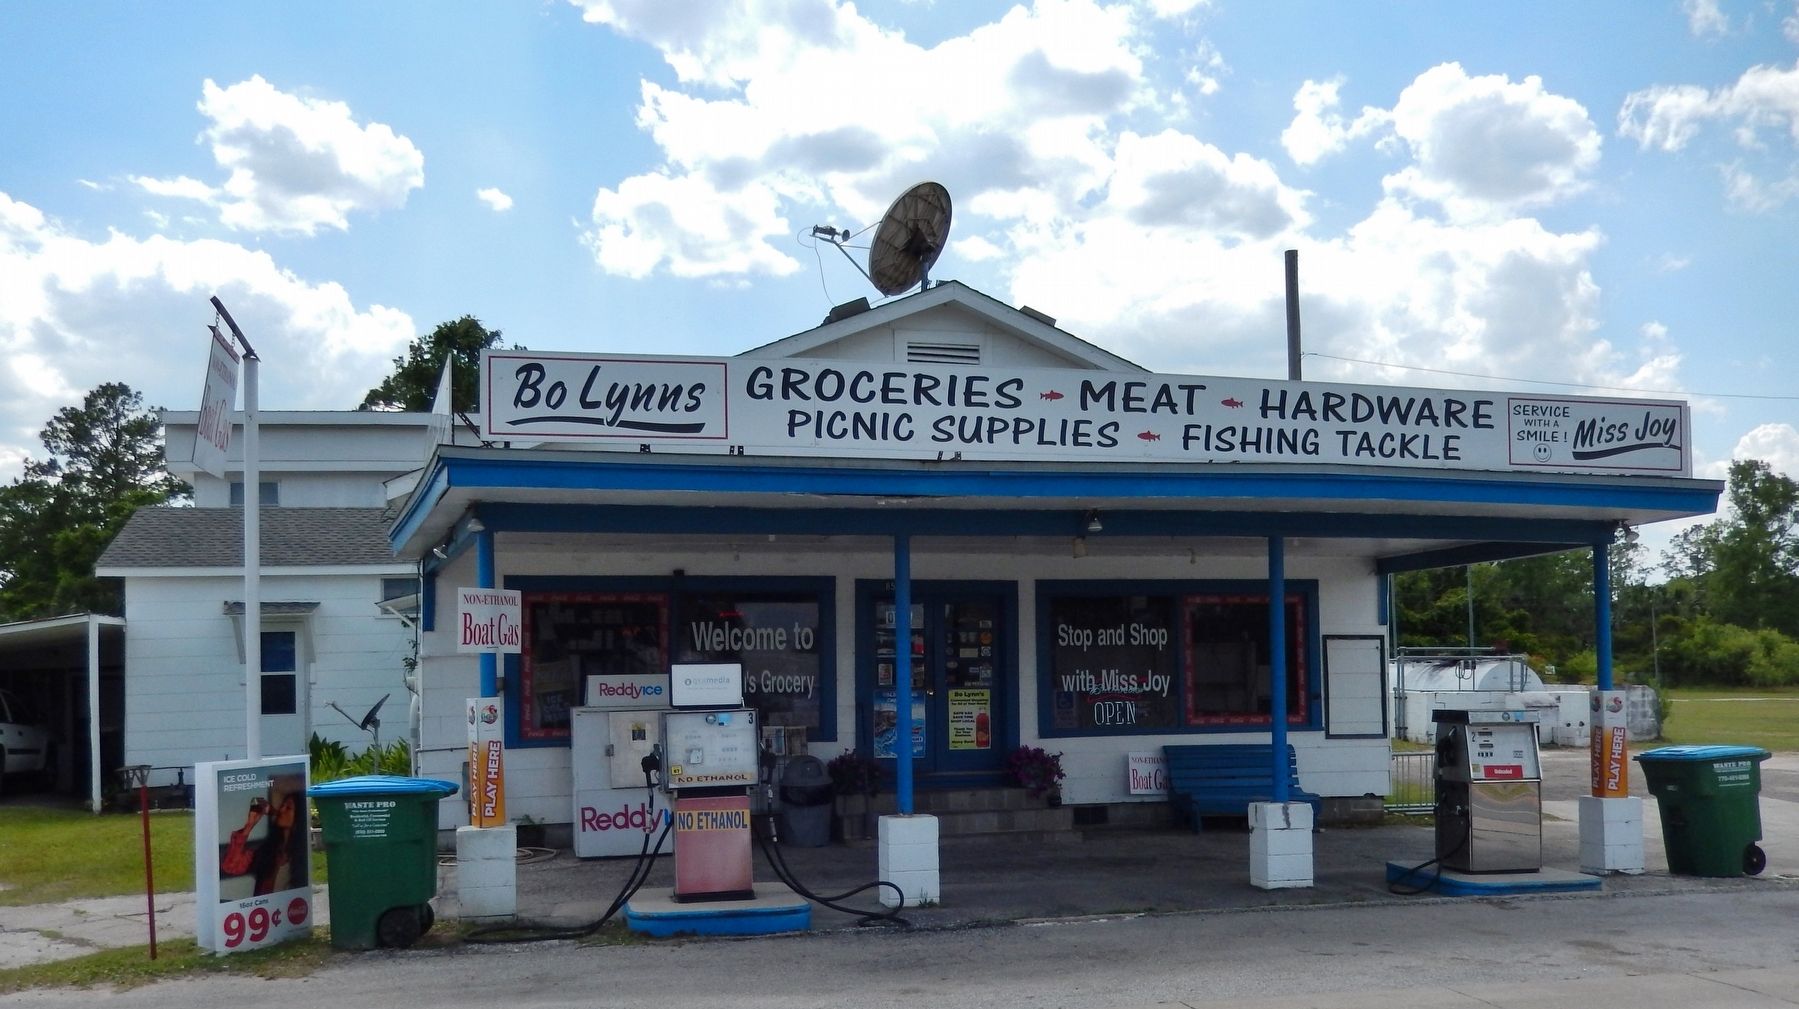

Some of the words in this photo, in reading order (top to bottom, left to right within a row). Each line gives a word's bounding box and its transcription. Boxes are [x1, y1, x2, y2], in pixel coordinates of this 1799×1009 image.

[515, 363, 568, 411] Bo
[579, 365, 706, 427] Lynns
[746, 366, 1024, 409] GROCERIES
[1080, 380, 1207, 417] MEAT
[1259, 389, 1494, 430] HARDWARE
[1513, 404, 1570, 418] SERVICE
[1524, 418, 1550, 428] WITH
[1553, 420, 1560, 428] A
[787, 409, 915, 442] PICNIC
[931, 415, 1120, 448] SUPPLIES
[1182, 424, 1319, 456] FISHING
[1336, 430, 1461, 461] TACKLE
[1573, 416, 1629, 450] Miss
[1635, 411, 1677, 445] Joy
[463, 593, 519, 606] NON-ETHANOL
[462, 612, 495, 646] Boat
[498, 613, 519, 646] Gas
[692, 621, 787, 651] Welcome
[794, 622, 814, 650] to
[1058, 624, 1093, 651] Stop
[1098, 624, 1125, 646] and
[1130, 623, 1168, 650] Shop
[761, 670, 815, 699] Grocery
[1062, 669, 1096, 692] with
[1101, 669, 1138, 692] Miss
[1143, 670, 1170, 697] Joy
[748, 712, 754, 725] 3
[1094, 701, 1137, 726] OPEN
[1472, 732, 1476, 742] 2
[1611, 727, 1625, 759] HERE
[488, 741, 501, 779] HERE
[224, 775, 236, 784] ICE
[237, 773, 257, 782] COLD
[224, 780, 275, 792] REFRESHMENT
[697, 774, 748, 782] ETHANOL
[1132, 768, 1152, 790] Boat
[1154, 768, 1168, 791] Ga
[1608, 760, 1621, 791] PLAY
[344, 801, 375, 809] WASTE
[376, 800, 396, 808] PRO
[485, 781, 498, 817] PLAY
[678, 812, 693, 830] NO
[698, 810, 748, 829] ETHANOL
[223, 907, 282, 948] 99¢
